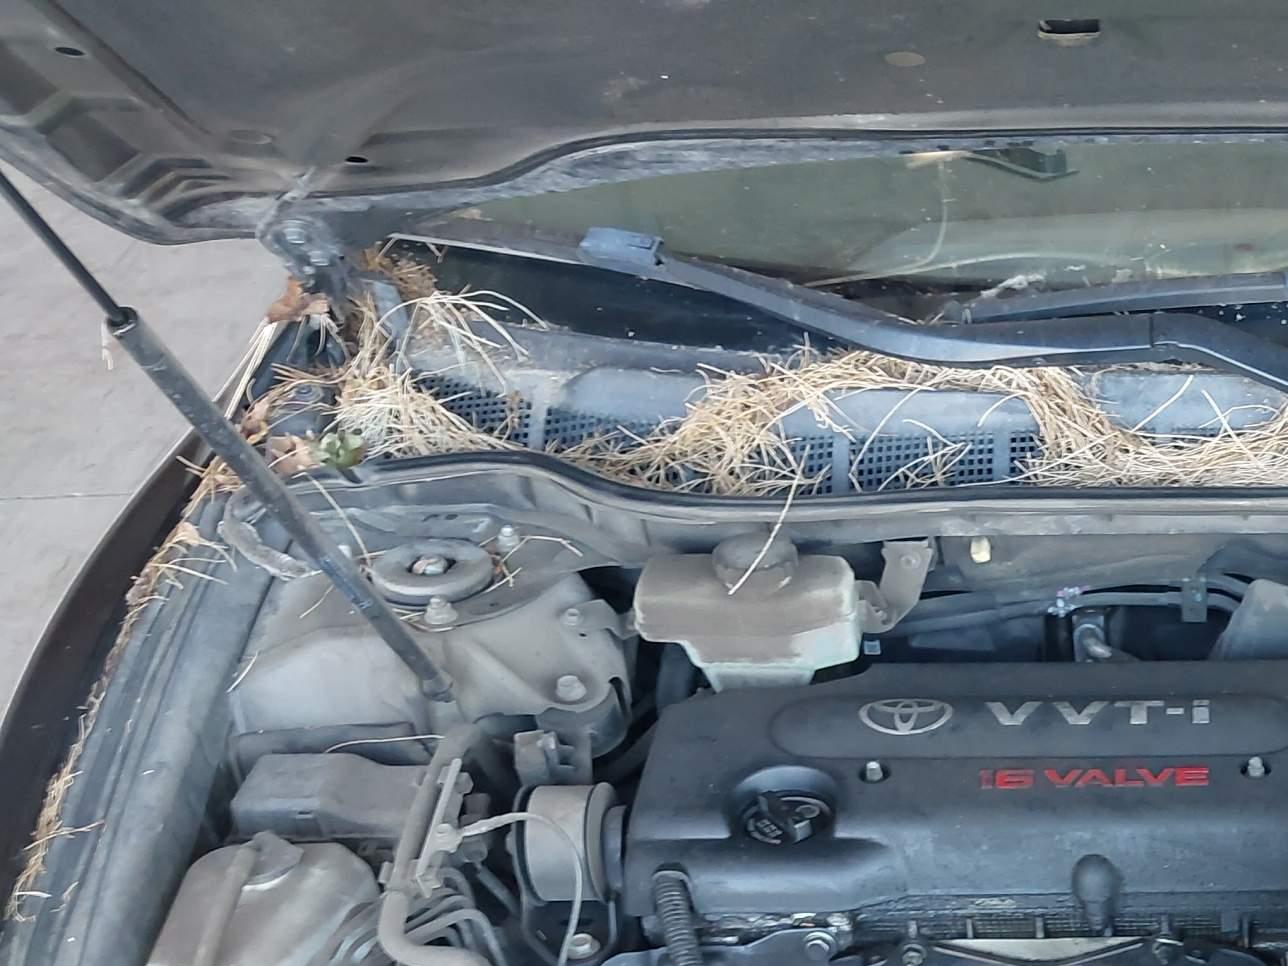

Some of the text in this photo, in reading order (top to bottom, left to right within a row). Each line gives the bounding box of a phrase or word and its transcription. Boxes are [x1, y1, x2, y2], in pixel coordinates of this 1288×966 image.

[984, 699, 1210, 726] VVT-i
[979, 766, 1210, 790] 16 VALVE
